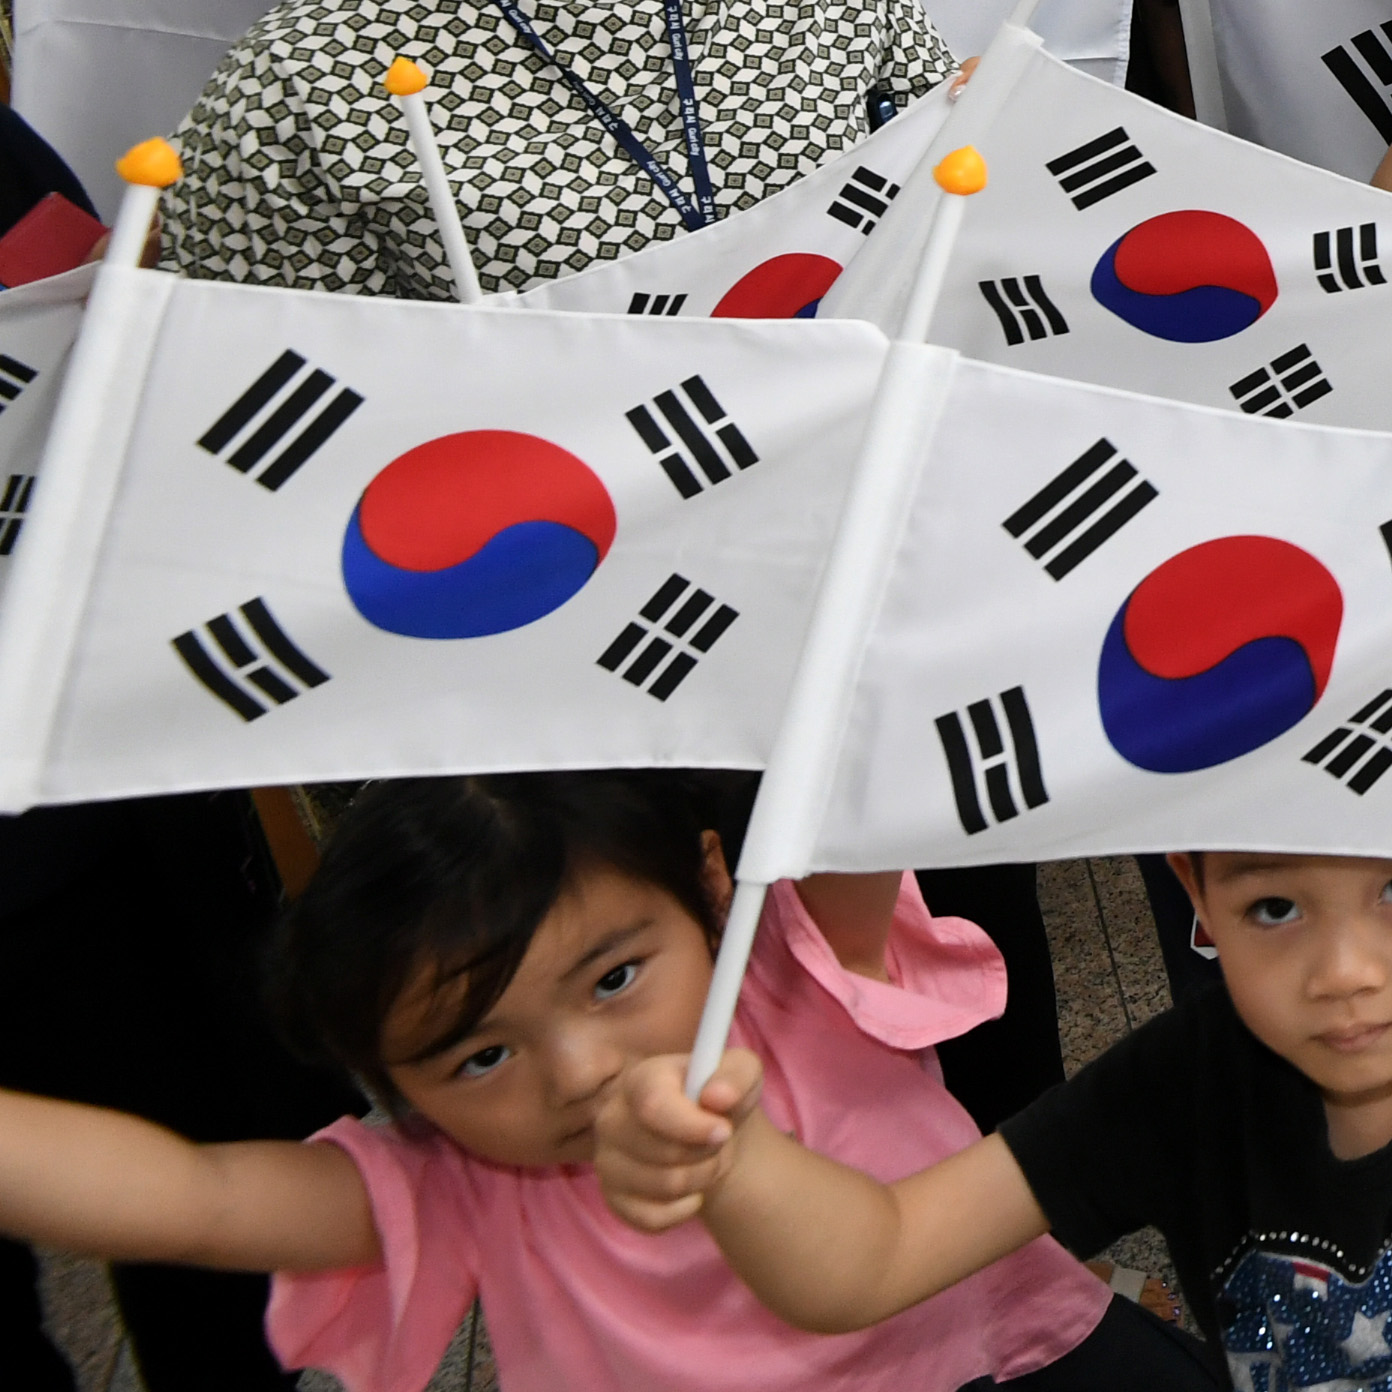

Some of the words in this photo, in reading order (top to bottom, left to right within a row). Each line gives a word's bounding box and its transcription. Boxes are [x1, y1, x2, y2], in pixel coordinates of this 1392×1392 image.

[667, 5, 681, 30] 구리시
[672, 32, 682, 48] Guri
[674, 48, 684, 61] city
[595, 106, 619, 132] 구리시
[682, 98, 696, 124] 구리시
[688, 127, 698, 144] Guri
[690, 143, 701, 157] city
[668, 188, 692, 215] 구리시
[701, 195, 716, 224] 구리시
